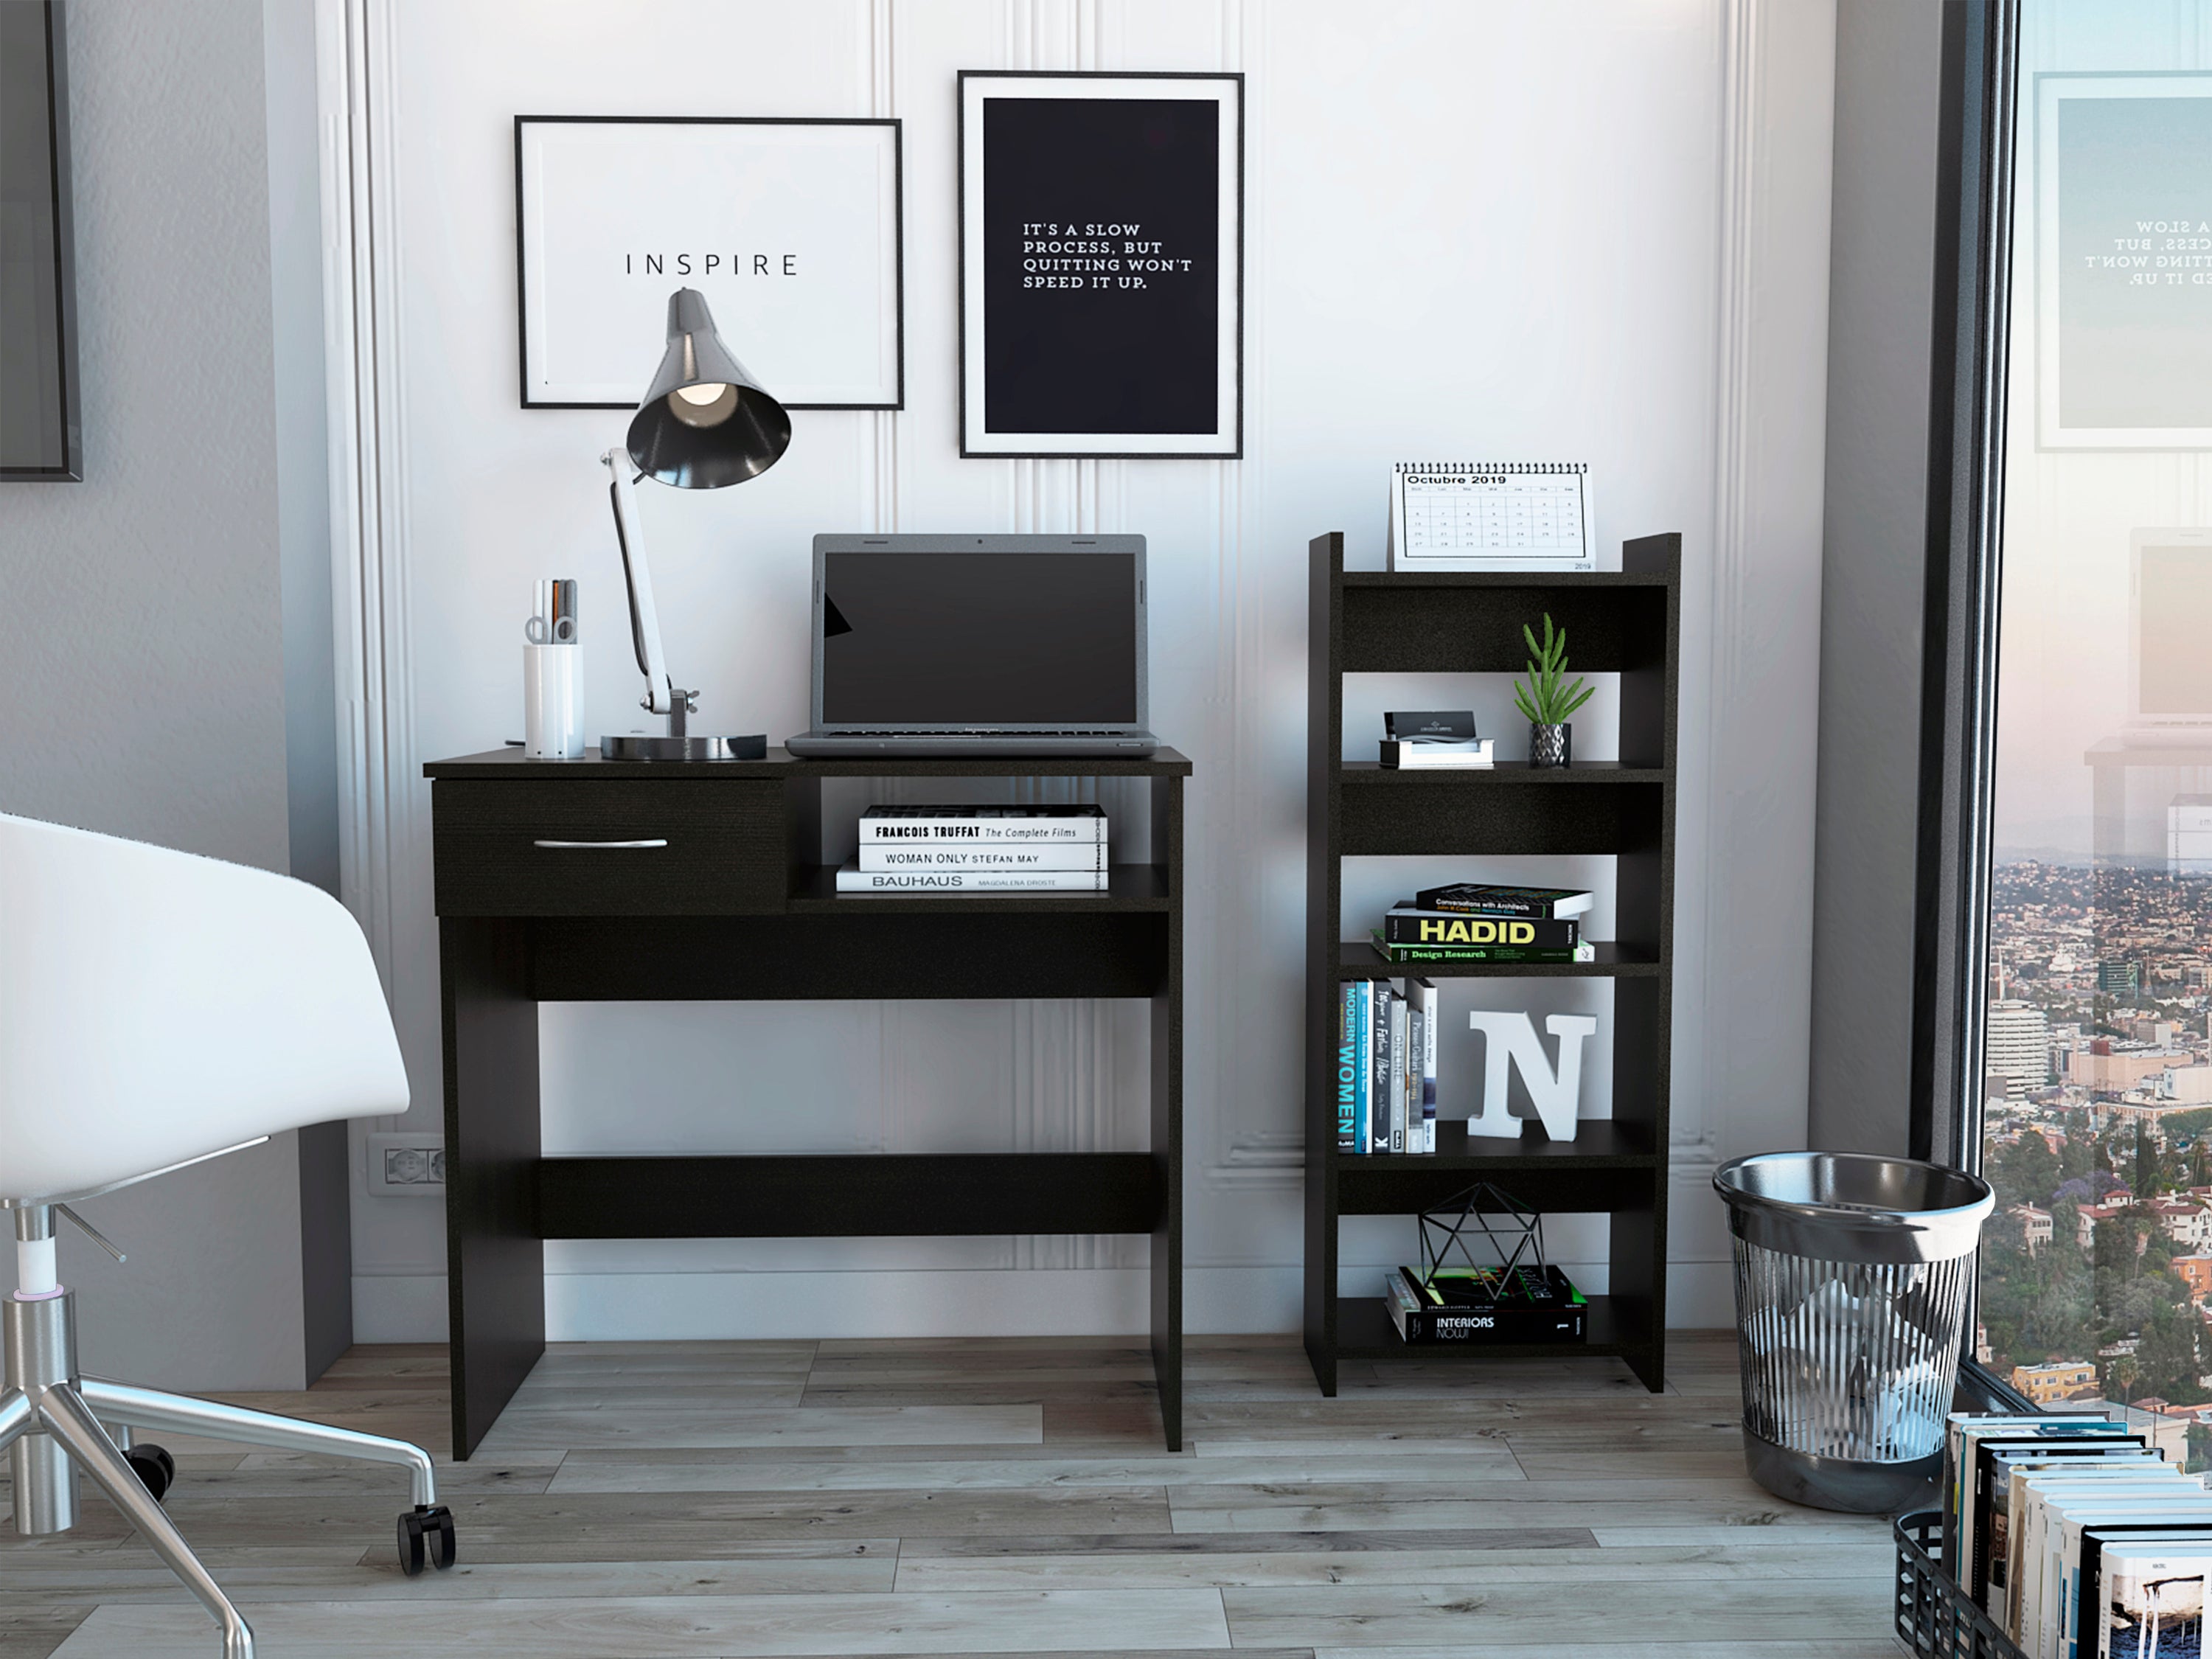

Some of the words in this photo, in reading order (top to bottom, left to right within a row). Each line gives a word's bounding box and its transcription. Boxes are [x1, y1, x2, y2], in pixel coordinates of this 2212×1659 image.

[1023, 223, 1058, 236] IT'S
[1065, 224, 1078, 236] A
[1085, 223, 1141, 236] SLOW
[1023, 241, 1116, 255] PROCESS,
[1124, 241, 1162, 254] BUT
[627, 254, 798, 276] INSPIRE
[1023, 259, 1120, 272] QUITTING
[1127, 259, 1192, 271] WON'T
[1023, 276, 1084, 288] SPEED
[1092, 276, 1111, 288] IT
[1118, 276, 1147, 289] UP.
[1408, 476, 1466, 484] Octubre
[1471, 476, 1506, 484] 2019
[876, 826, 929, 838] FRANCOIS
[933, 826, 980, 838] TRUFFAT
[986, 828, 1002, 838] The
[1005, 828, 1049, 839] Complete
[1051, 827, 1077, 838] Films
[886, 853, 932, 864] WOMAN
[936, 853, 968, 864] ONLY
[972, 855, 1013, 864] STEFAN
[1018, 855, 1040, 863] MAY
[872, 875, 963, 887] BAUHAUS
[1419, 919, 1536, 945] HADID
[1411, 950, 1443, 960] Design
[1444, 950, 1486, 959] Research
[1346, 988, 1356, 1043] MODERN
[1467, 1011, 1597, 1142] N
[1338, 1045, 1355, 1134] WOMEN
[1437, 1317, 1495, 1328] INTERIORS
[1436, 1328, 1469, 1339] NOW!
